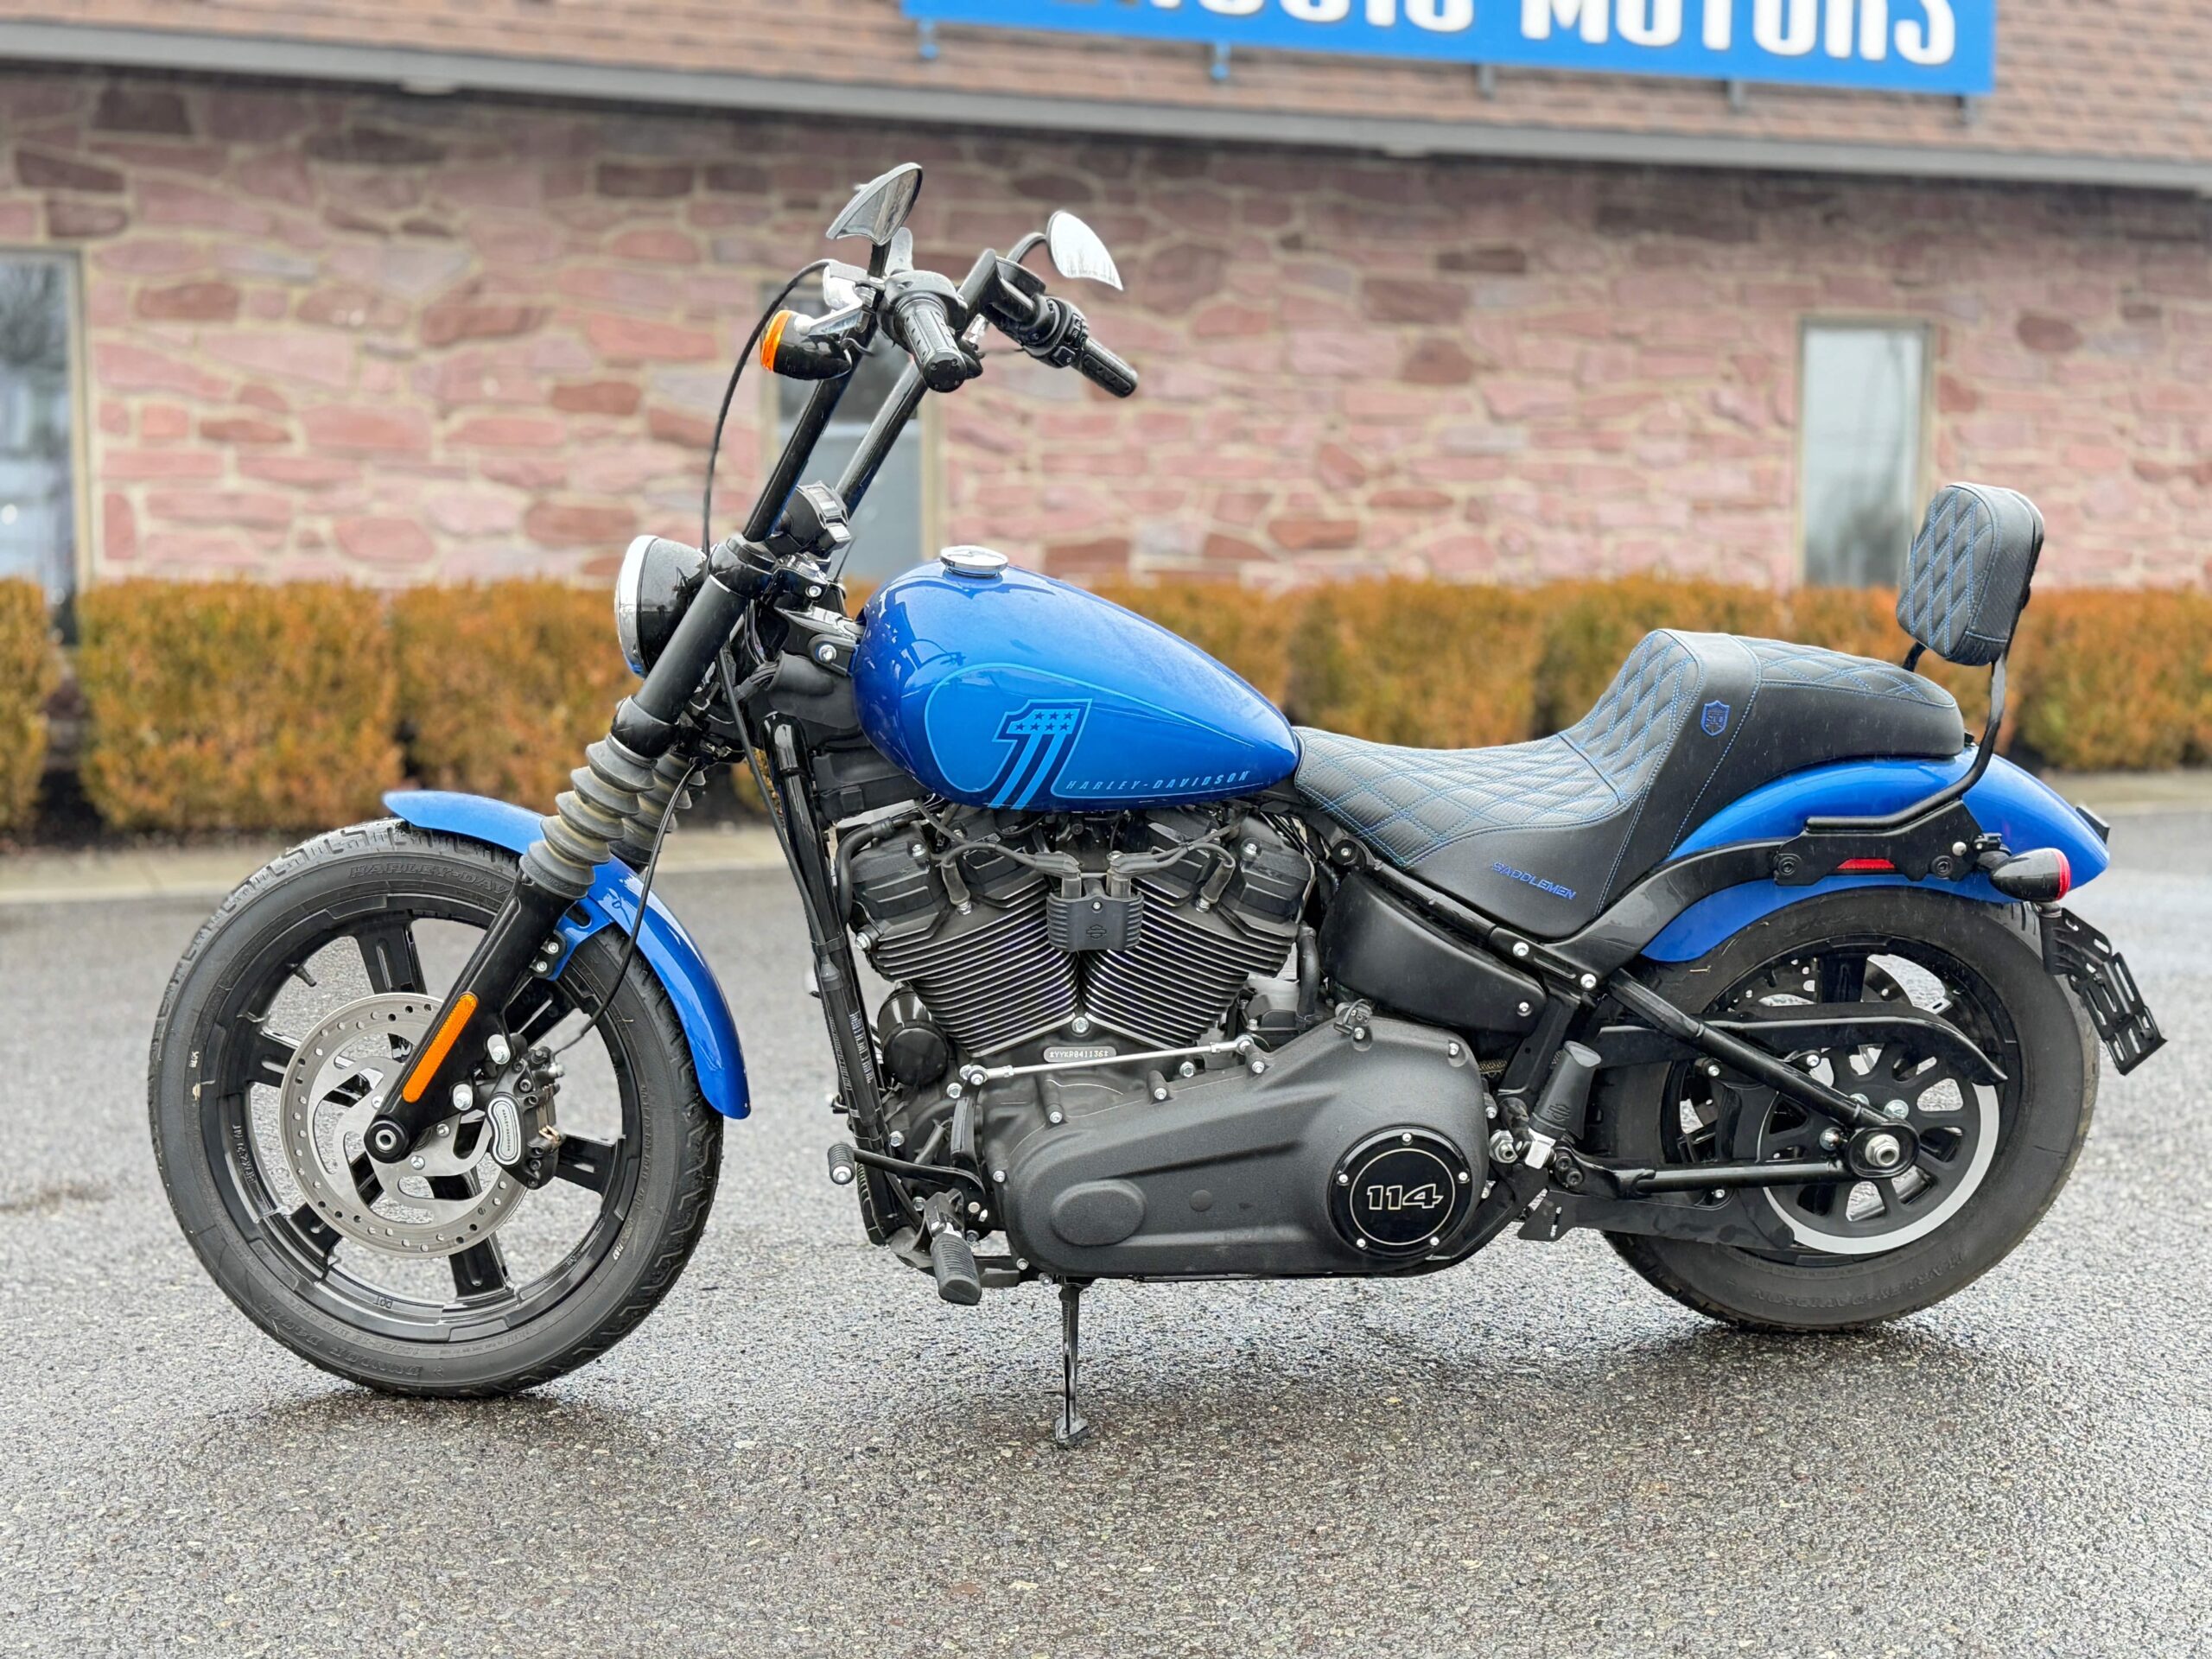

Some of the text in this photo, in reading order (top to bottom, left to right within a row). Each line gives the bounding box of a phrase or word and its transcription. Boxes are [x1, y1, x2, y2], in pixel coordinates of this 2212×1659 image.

[1065, 770, 1250, 790] HARLEY-DAVIDSON
[350, 863, 512, 894] HARLEY-DAV
[1491, 861, 1577, 900] SADDLEMEN
[1366, 1183, 1444, 1211] 114
[329, 1346, 423, 1376] DUNLOP
